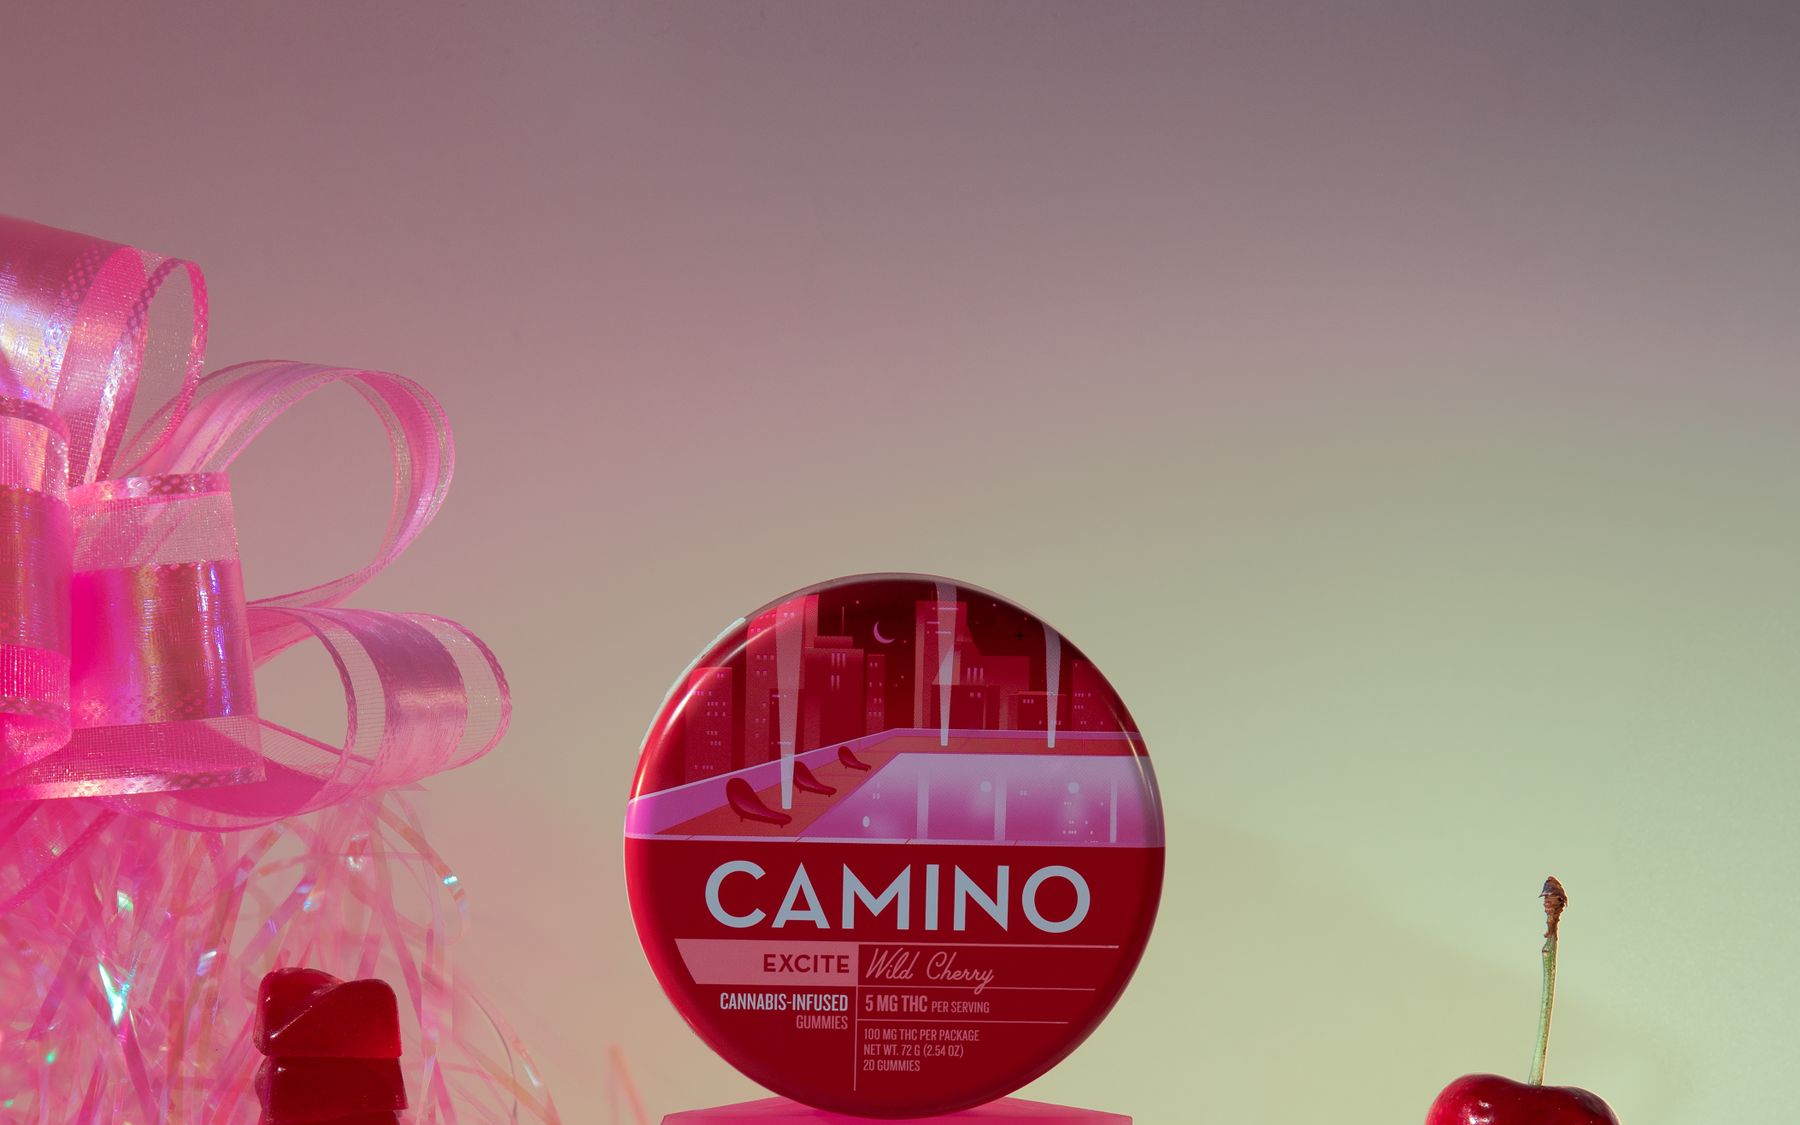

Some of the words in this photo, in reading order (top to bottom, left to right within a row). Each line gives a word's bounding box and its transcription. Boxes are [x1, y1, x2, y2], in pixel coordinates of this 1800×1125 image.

[705, 860, 1091, 933] CAMINO
[763, 954, 850, 974] EXCITE
[865, 947, 920, 980] Wild
[926, 951, 995, 995] Cherry
[719, 992, 848, 1011] CANNABIS-INFUSED
[865, 994, 874, 1012] 5
[876, 994, 899, 1012] MG
[900, 995, 928, 1013] THC
[931, 1001, 949, 1013] PER
[950, 1001, 990, 1014] SERVING
[795, 1014, 848, 1030] GUMMIES
[864, 1028, 880, 1041] 100
[882, 1028, 897, 1041] MG
[899, 1028, 918, 1041] THC
[919, 1029, 937, 1041] PER
[939, 1029, 980, 1042] PACKAGE
[863, 1043, 881, 1056] NET
[883, 1044, 899, 1056] WT.
[901, 1044, 912, 1057] 72
[913, 1044, 921, 1057] G
[923, 1044, 946, 1058] (2.54
[947, 1044, 965, 1059] OZ)
[863, 1059, 875, 1072] 20
[877, 1059, 921, 1072] GUMMIES
